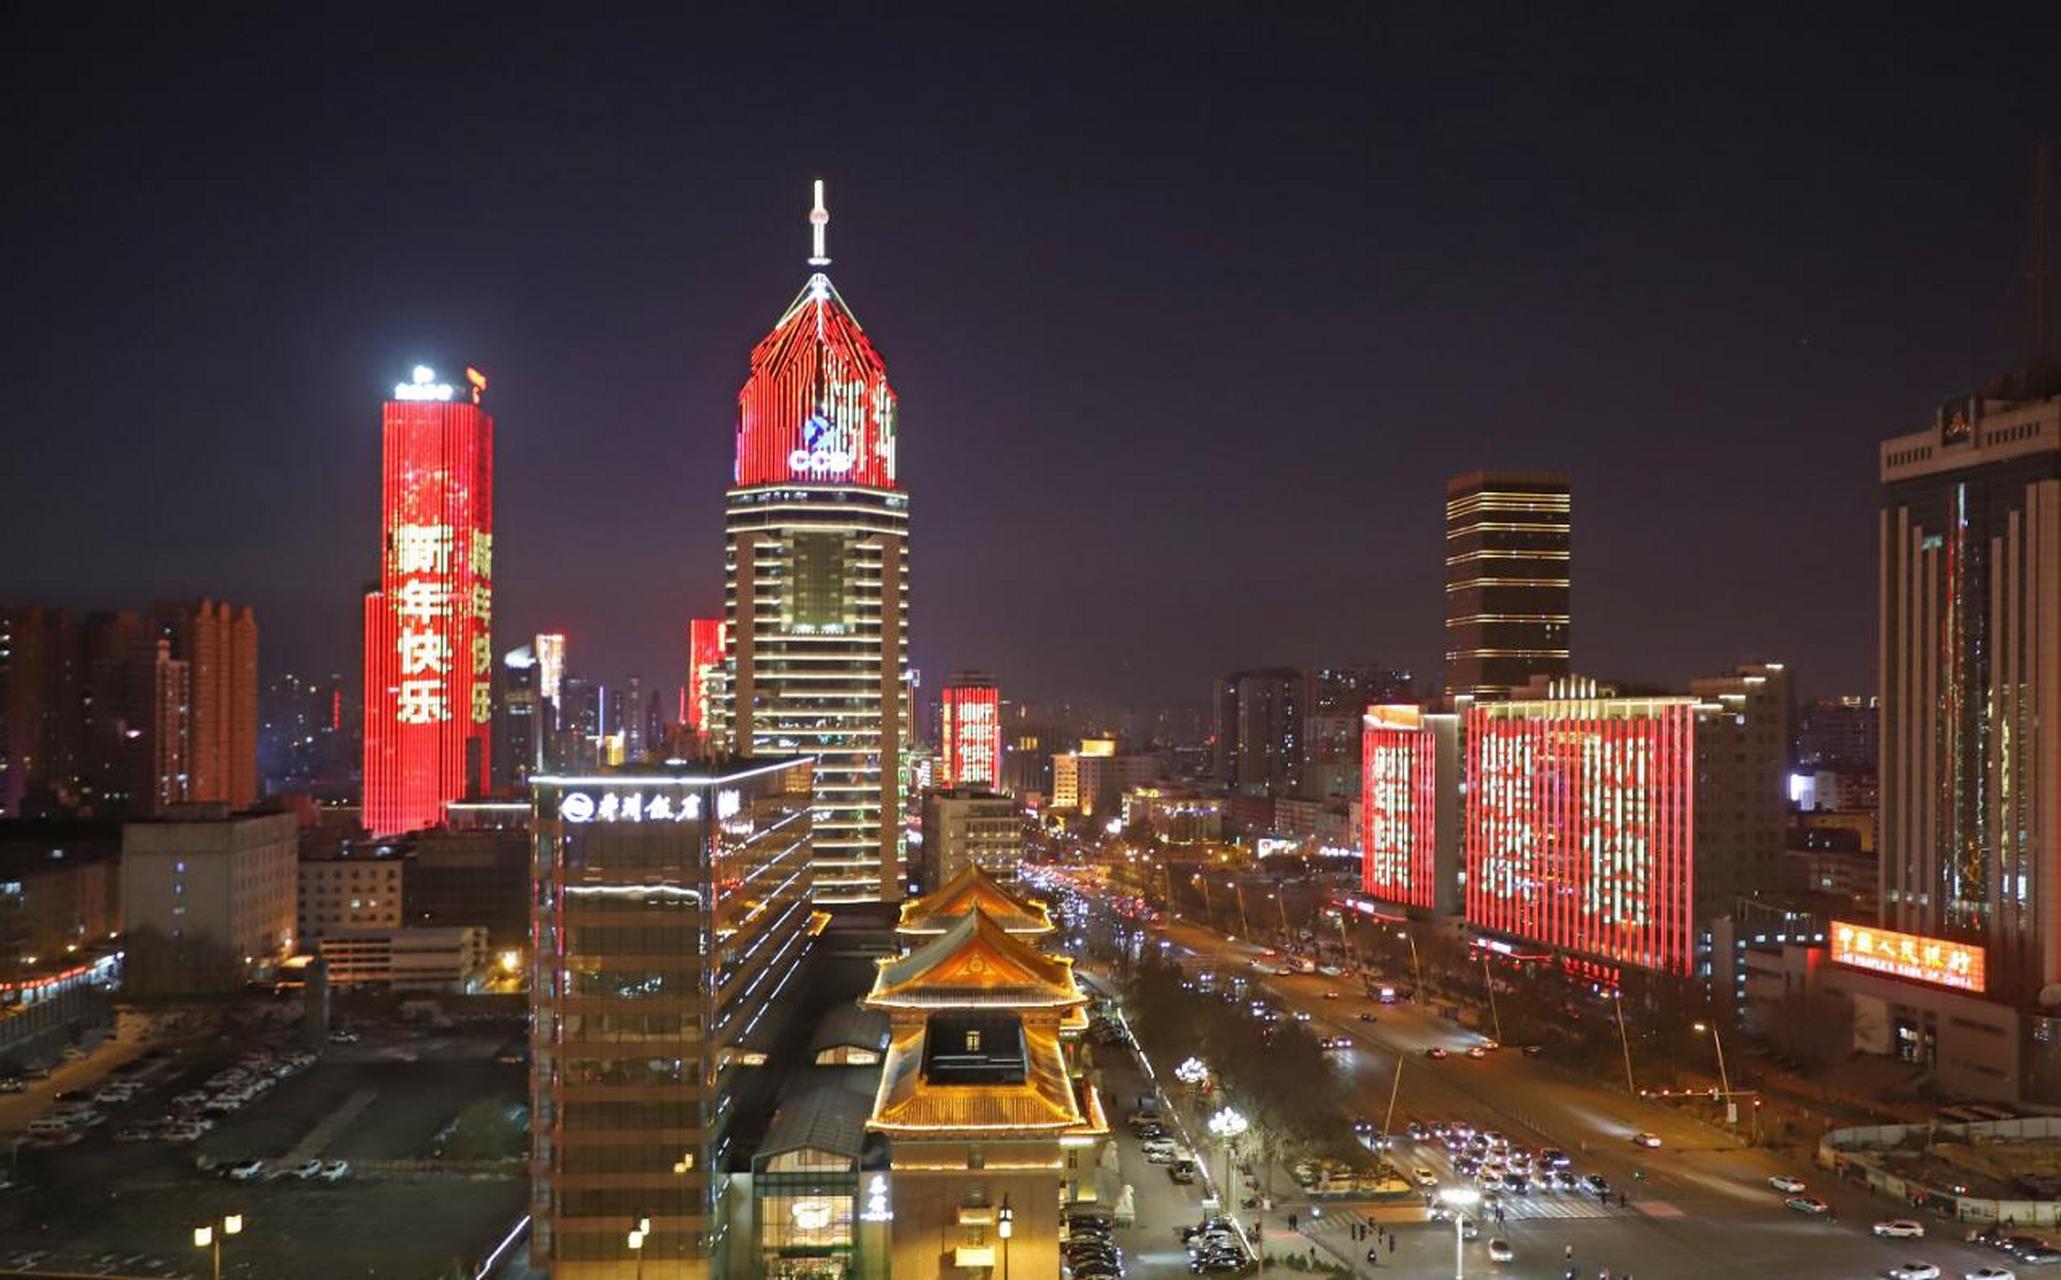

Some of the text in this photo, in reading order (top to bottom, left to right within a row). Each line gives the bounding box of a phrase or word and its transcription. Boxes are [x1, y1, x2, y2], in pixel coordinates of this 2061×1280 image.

[397, 526, 453, 724] 新年快乐
[473, 529, 493, 724] 新年快乐
[1838, 927, 1973, 975] 中国人民银行
